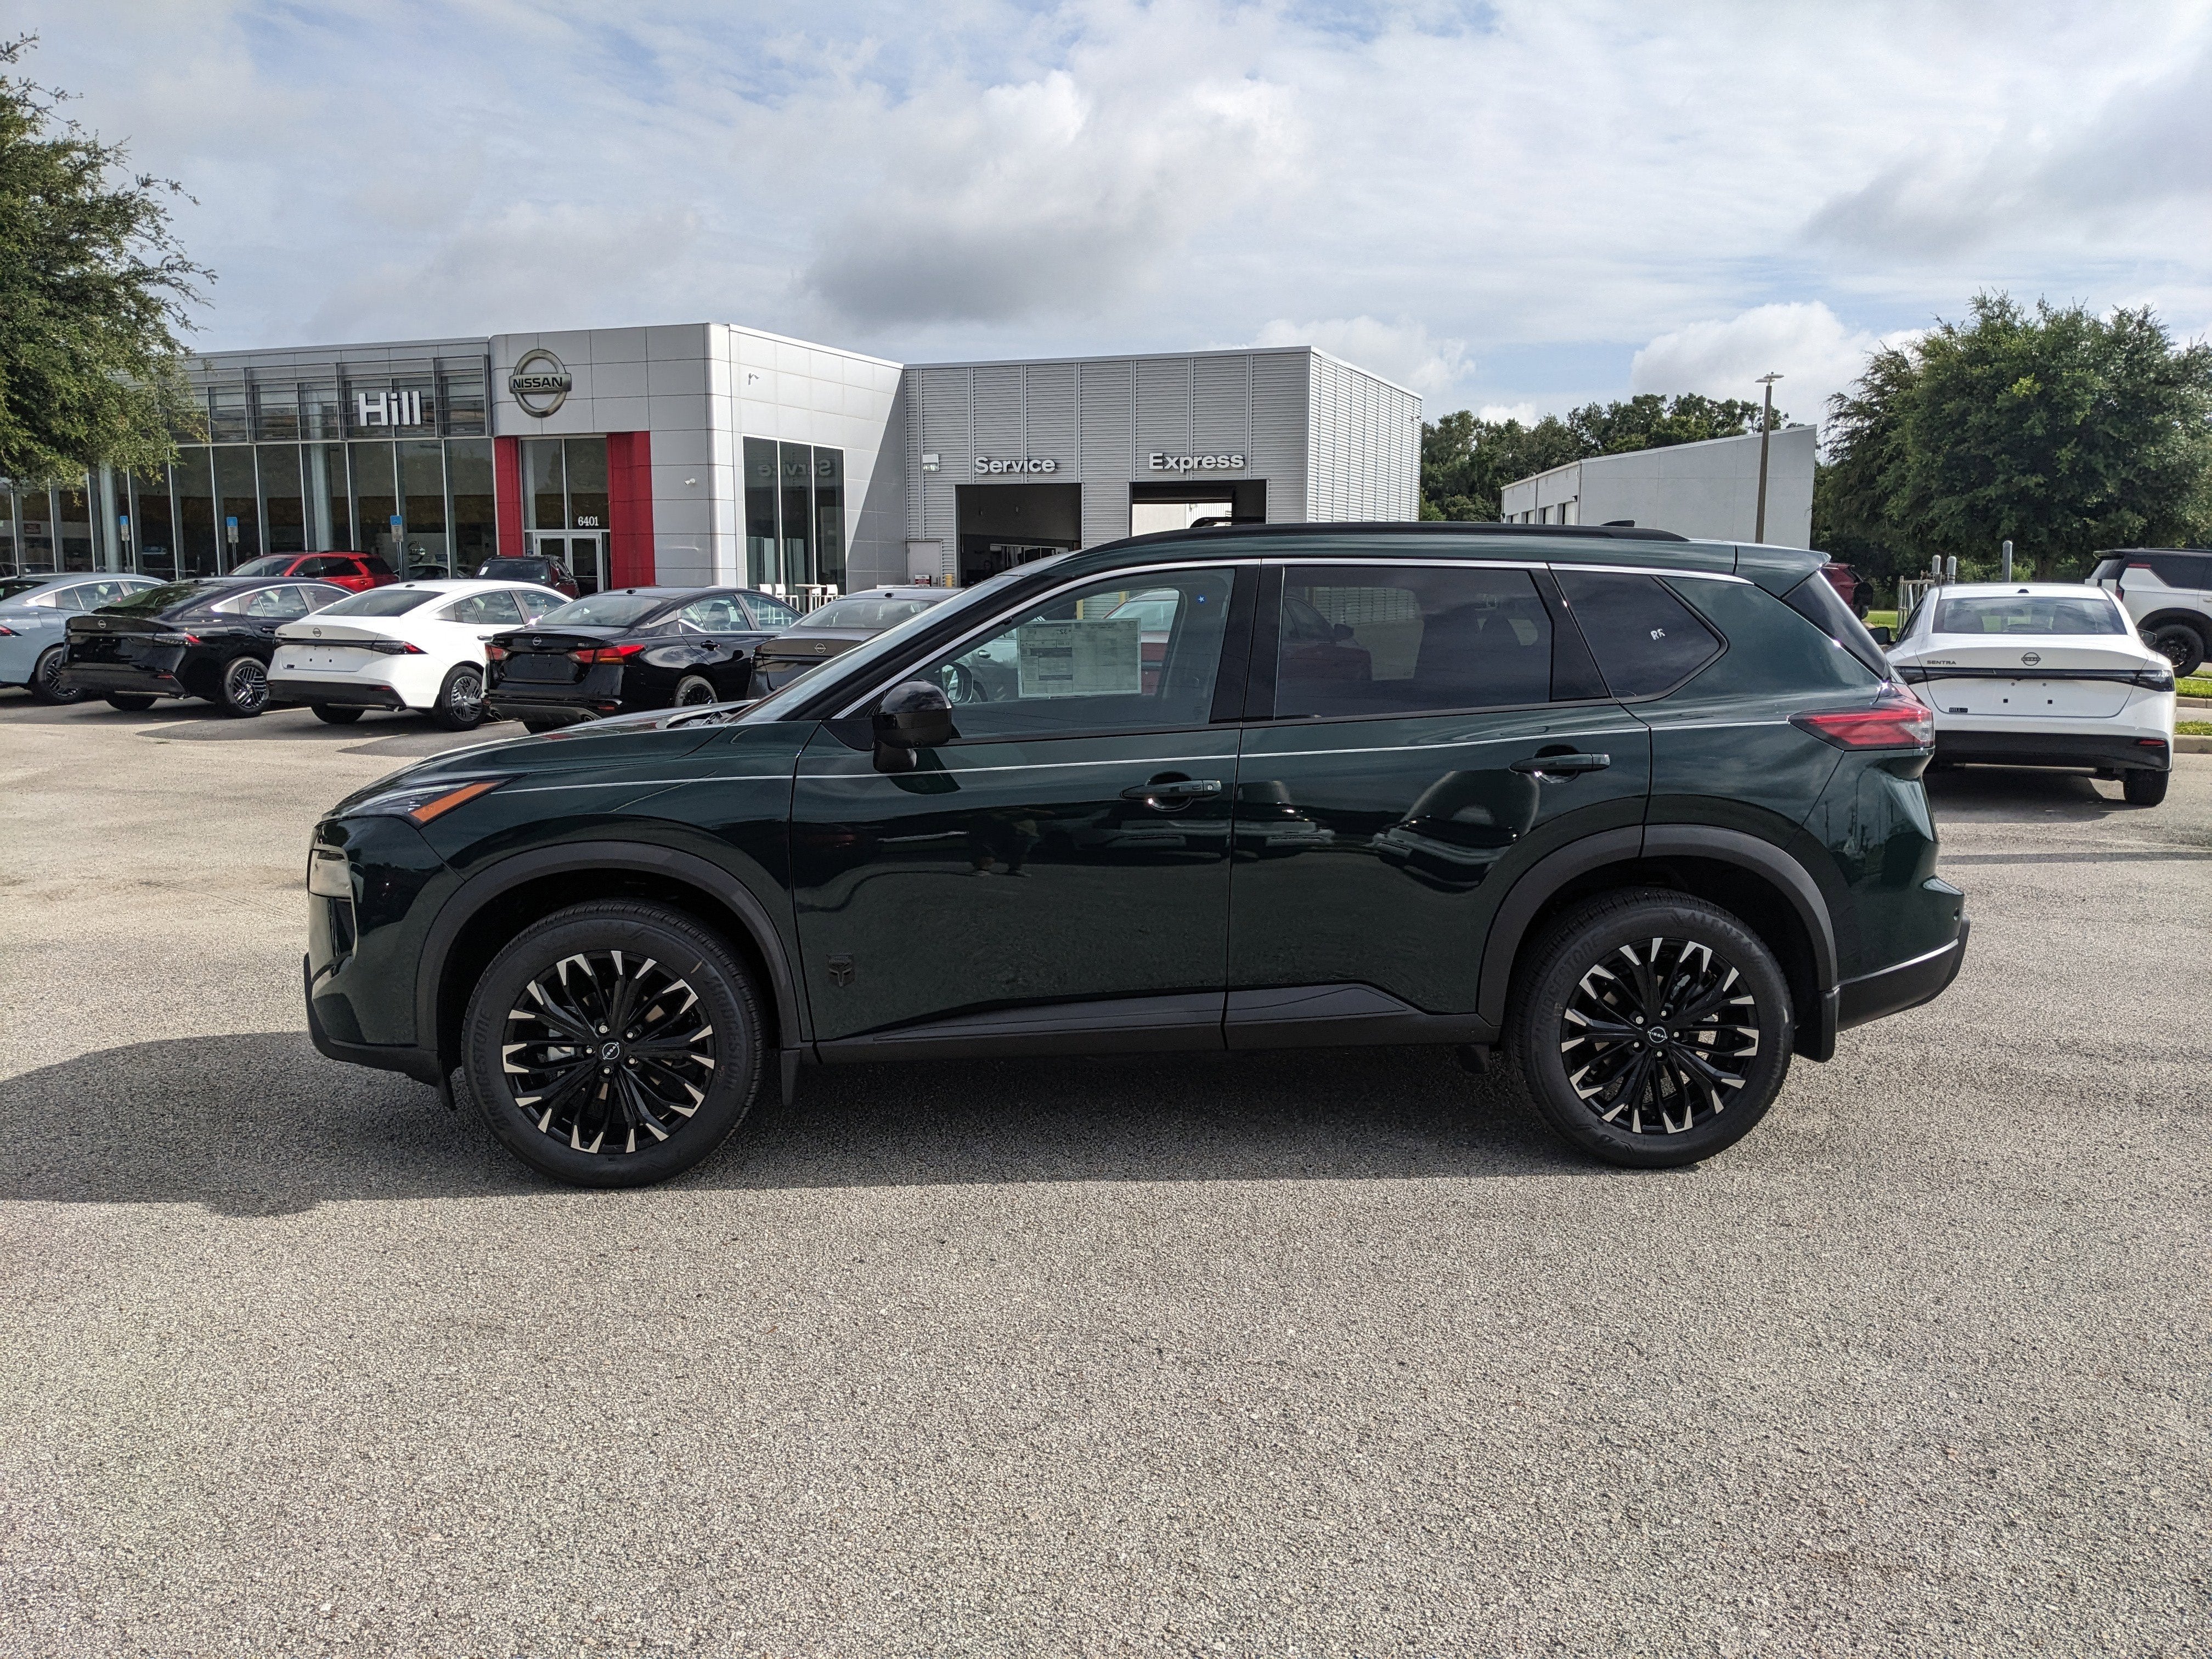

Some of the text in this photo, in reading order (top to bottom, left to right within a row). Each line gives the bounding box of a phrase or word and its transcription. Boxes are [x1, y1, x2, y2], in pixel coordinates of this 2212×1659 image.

[513, 377, 563, 388] NISSAN
[358, 391, 421, 426] Hill
[974, 456, 1056, 473] Service
[1149, 453, 1244, 473] Express
[578, 516, 599, 526] 6401
[469, 1006, 515, 1133] BRIDGESTONE
